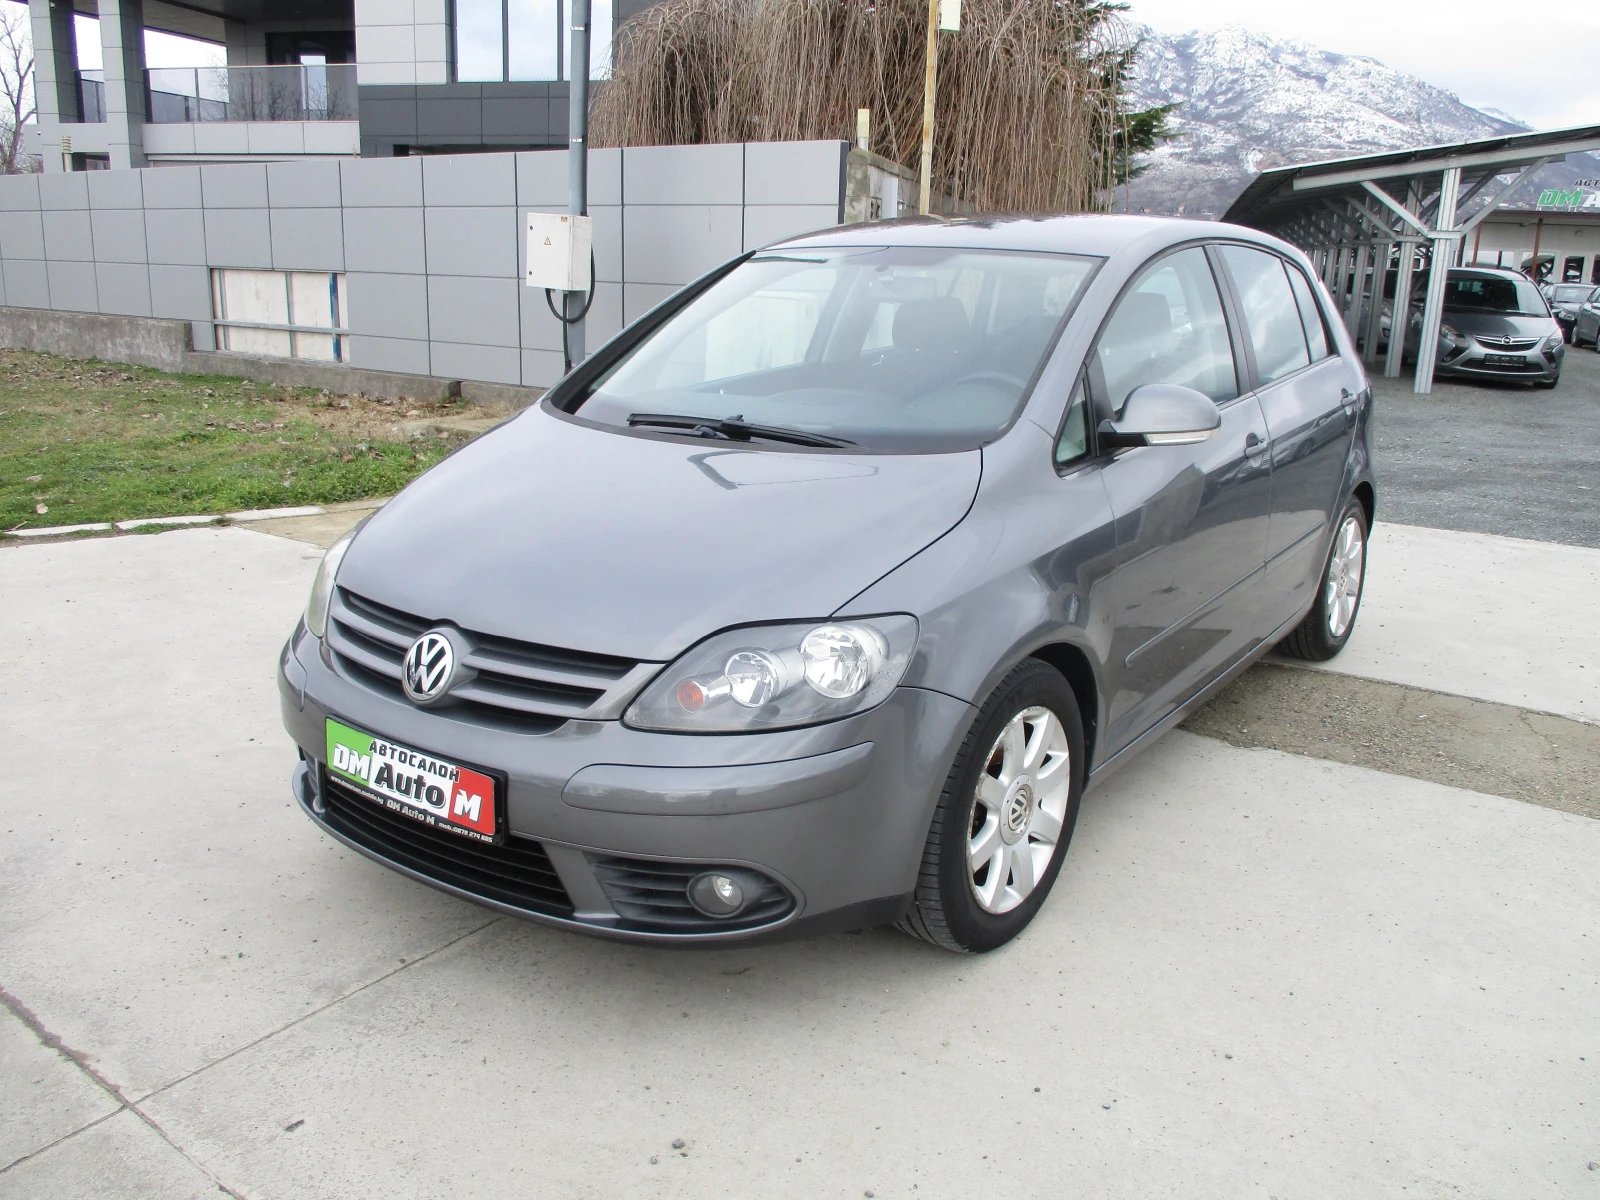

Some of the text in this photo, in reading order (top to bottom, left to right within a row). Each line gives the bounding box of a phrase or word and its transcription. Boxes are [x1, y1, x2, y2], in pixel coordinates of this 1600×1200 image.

[1537, 188, 1583, 208] DM
[369, 740, 460, 782] АВТОСАЛОН
[333, 743, 483, 823] DM Auto M
[402, 806, 425, 821] Auto
[426, 815, 436, 826] M
